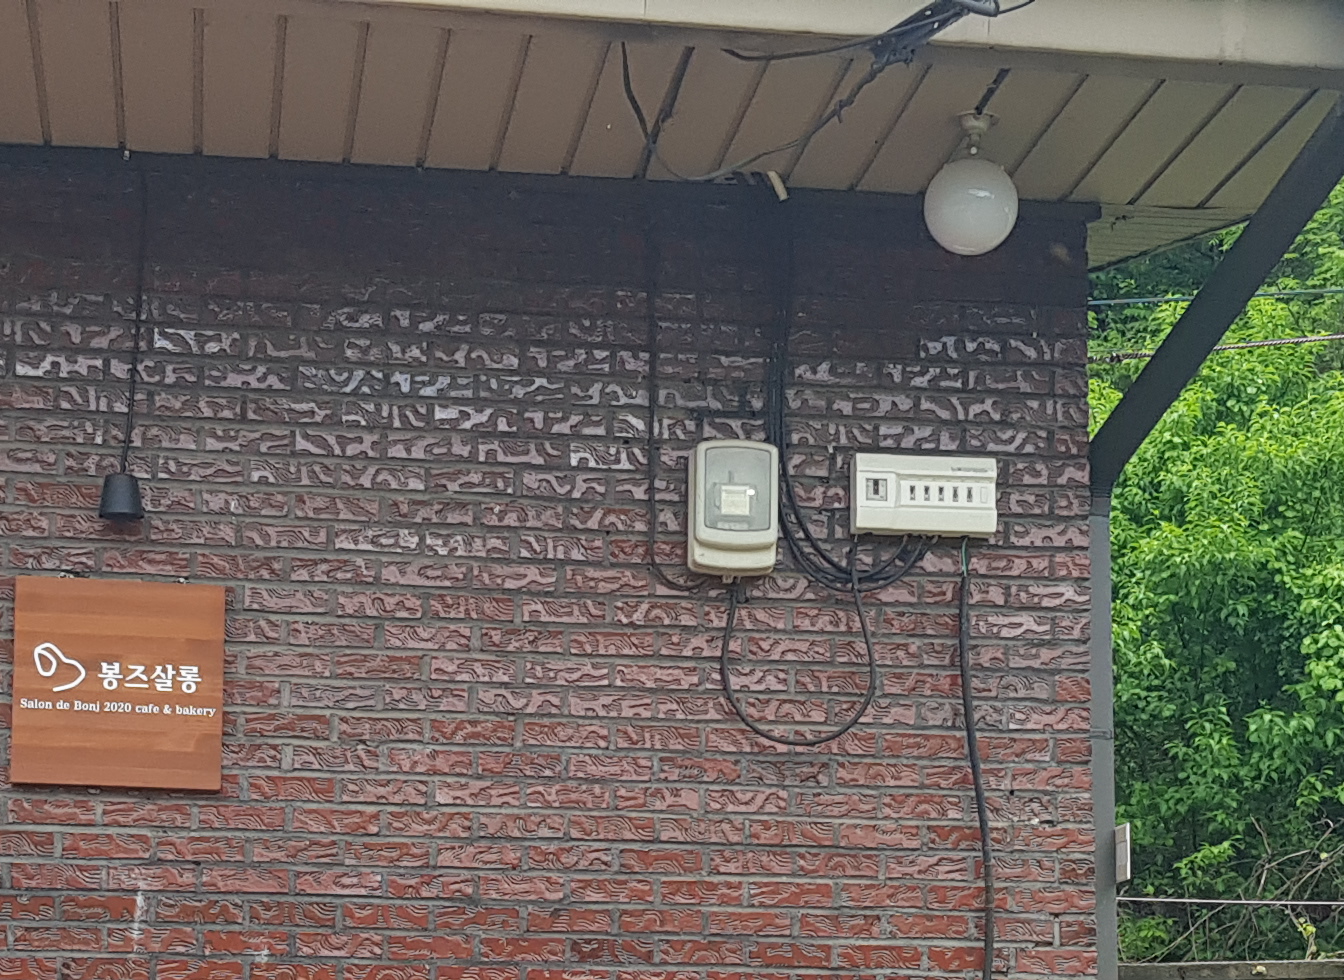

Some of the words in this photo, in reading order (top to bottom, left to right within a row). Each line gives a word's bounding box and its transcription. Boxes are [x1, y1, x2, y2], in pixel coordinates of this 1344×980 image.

[97, 661, 203, 693] 봉즈살롱
[19, 697, 54, 710] Salon
[56, 699, 70, 710] de
[73, 700, 100, 712] Bonj
[103, 702, 131, 713] 2020
[135, 703, 159, 714] cafe
[163, 704, 173, 714] &
[175, 704, 217, 717] bakery
